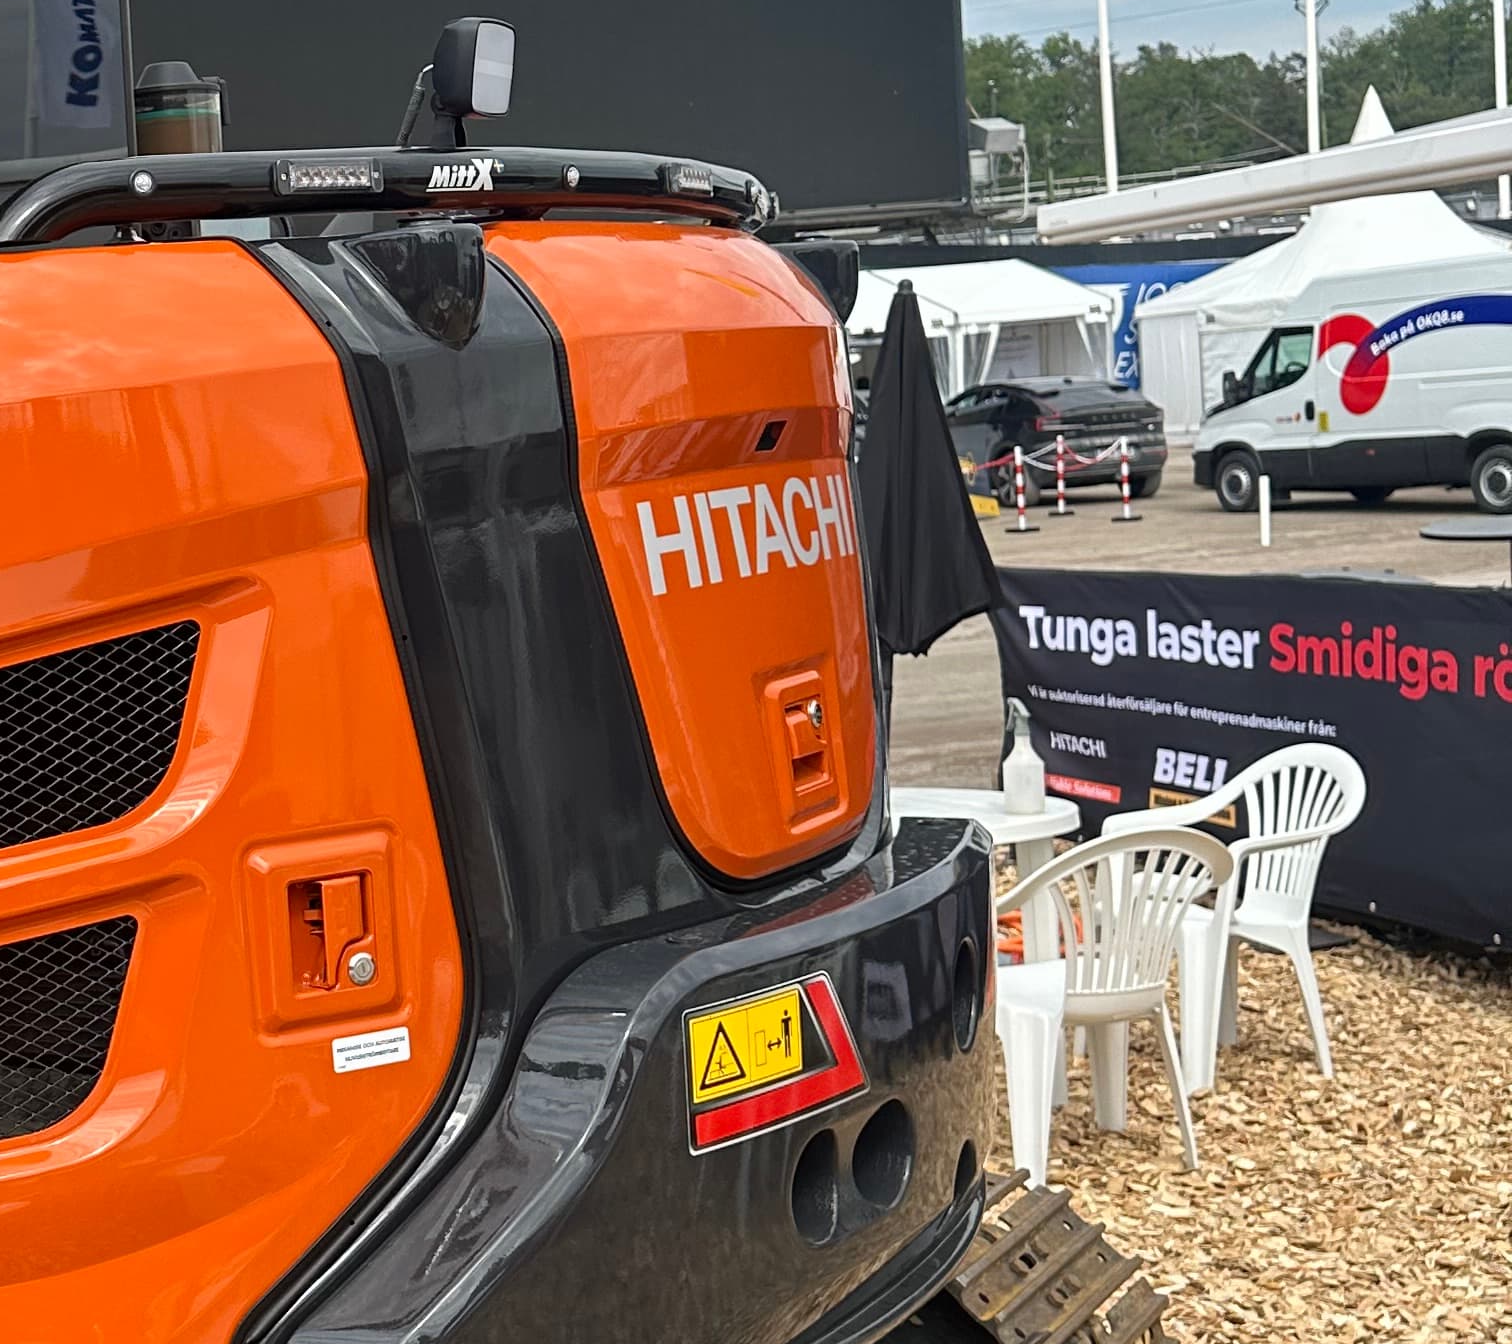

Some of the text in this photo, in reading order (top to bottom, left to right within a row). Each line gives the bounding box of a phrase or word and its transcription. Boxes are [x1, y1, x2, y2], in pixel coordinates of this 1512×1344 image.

[426, 158, 494, 193] MittX
[636, 474, 855, 597] HITACHI
[1019, 605, 1138, 666] Tunga
[1146, 608, 1261, 670] laster
[1268, 620, 1459, 701] Smidiga
[1173, 700, 1188, 717] för
[1190, 706, 1307, 734] entreprenadmaskiner
[1050, 731, 1107, 759] HITACHI
